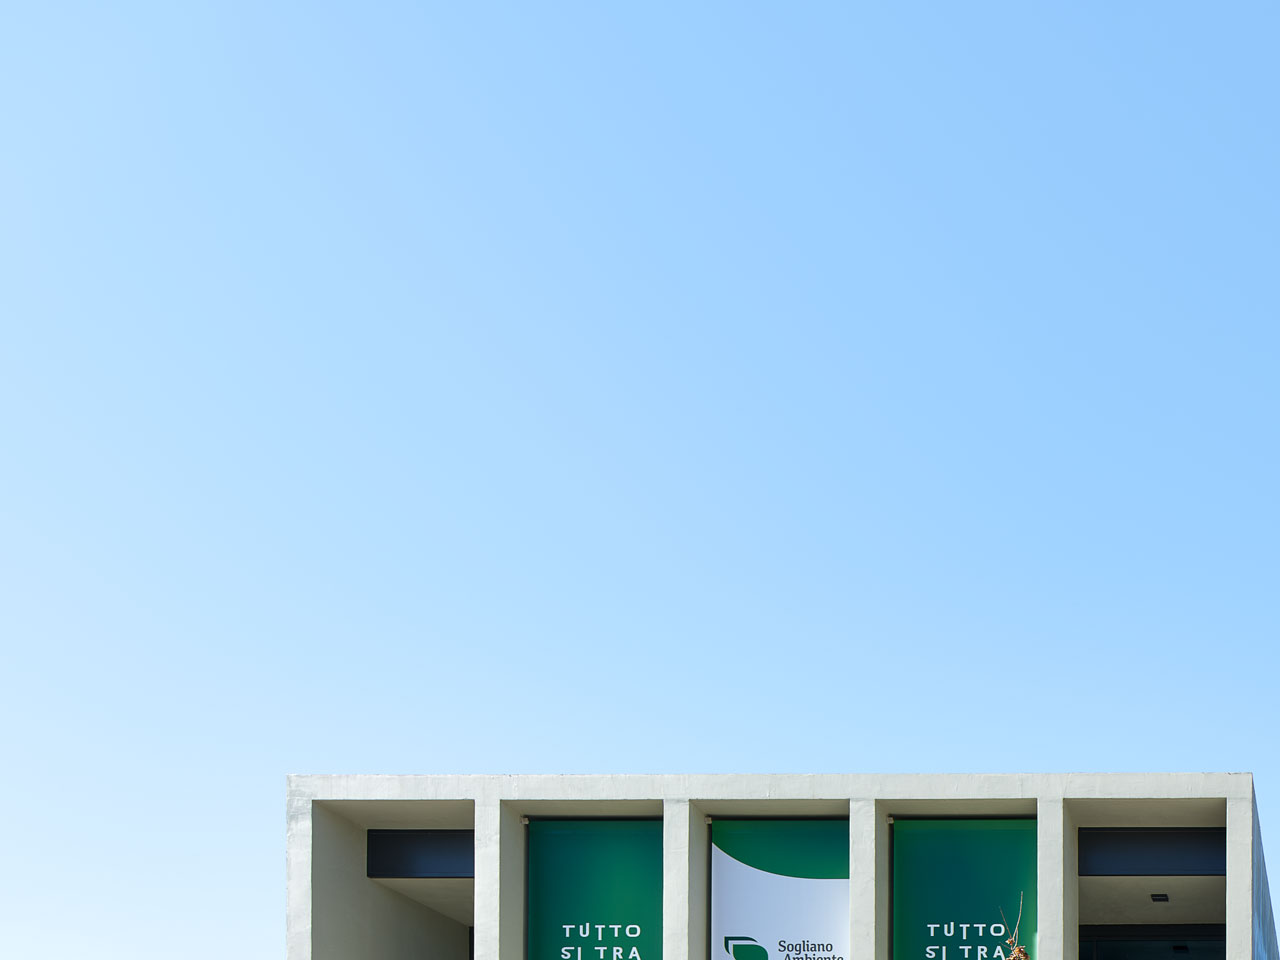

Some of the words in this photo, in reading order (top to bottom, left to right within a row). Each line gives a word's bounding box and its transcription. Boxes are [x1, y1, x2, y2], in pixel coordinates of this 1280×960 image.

[562, 923, 641, 941] TUTTO
[927, 921, 1006, 940] TUTTO
[778, 940, 833, 955] Sogliano
